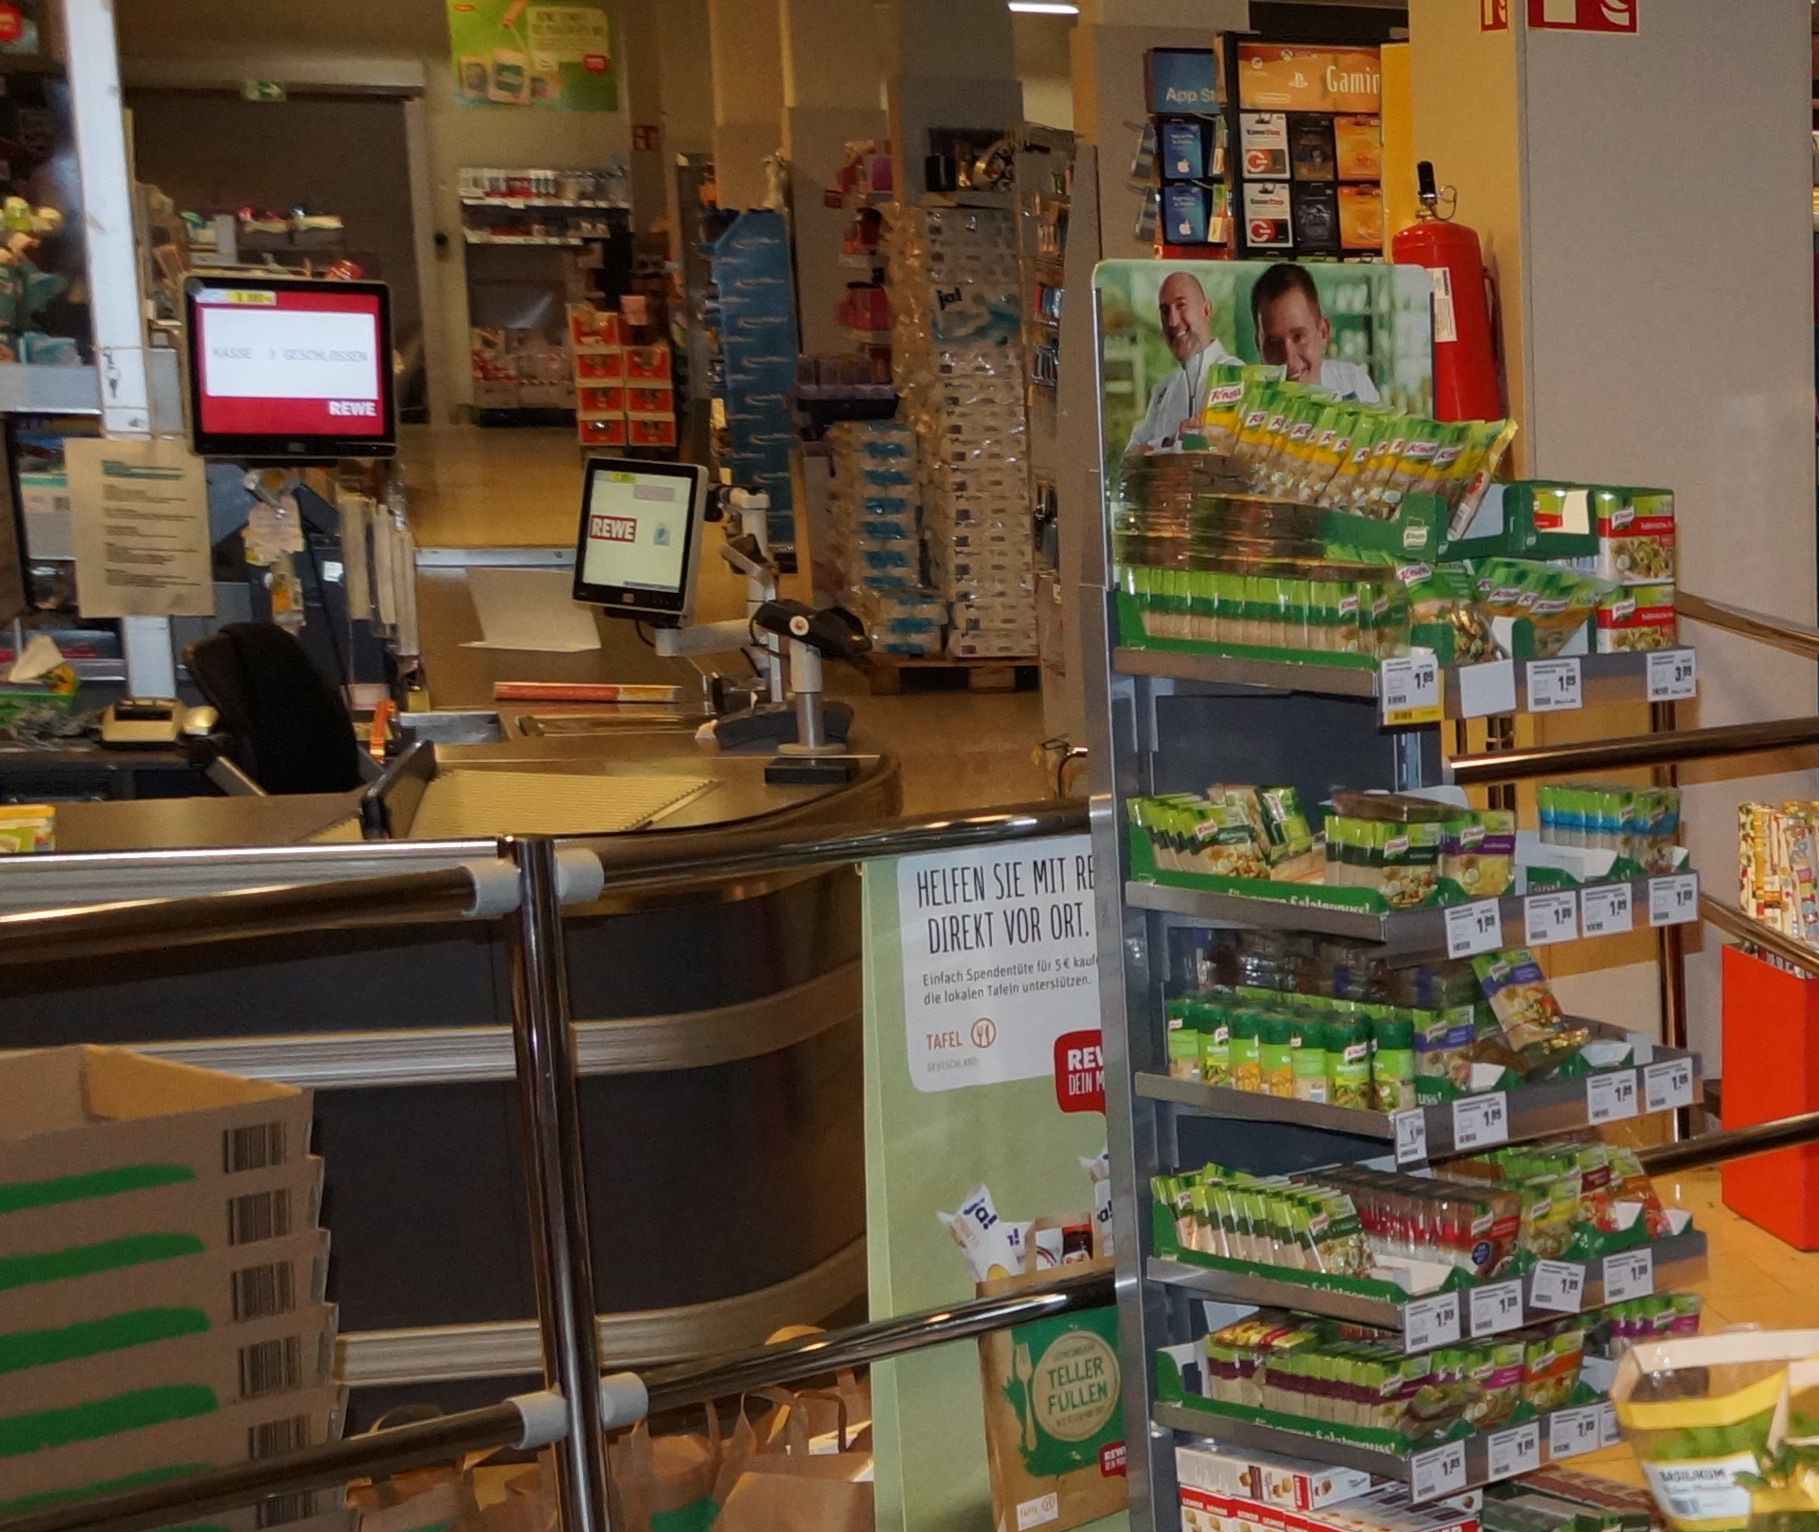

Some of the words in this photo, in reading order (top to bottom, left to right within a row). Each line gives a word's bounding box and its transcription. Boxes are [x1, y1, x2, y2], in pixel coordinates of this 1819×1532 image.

[1166, 86, 1197, 104] App
[213, 348, 253, 360] KASSE
[283, 348, 369, 363] GESCHLOSSEN
[329, 401, 377, 416] REWE
[591, 517, 635, 540] REWE
[916, 865, 985, 909] HELFEN
[993, 861, 1026, 900] SIE
[1033, 857, 1066, 896] MIT
[928, 911, 994, 955] DIREKT
[1003, 906, 1042, 946] VOR
[1050, 902, 1090, 940] ORT.
[922, 966, 964, 987] Einfach
[966, 960, 1034, 982] Spendentüte
[1037, 959, 1052, 973] für
[924, 991, 942, 1006] die
[944, 987, 984, 1003] lokalen
[988, 983, 1019, 998] Tafeln
[1022, 975, 1092, 994] unterstützen.
[926, 1030, 963, 1051] TAFEL
[1068, 1072, 1093, 1097] DEIN
[963, 1196, 999, 1231] ja!
[1046, 1355, 1105, 1390] TELLER
[1660, 1469, 1727, 1483] BASILIKUM
